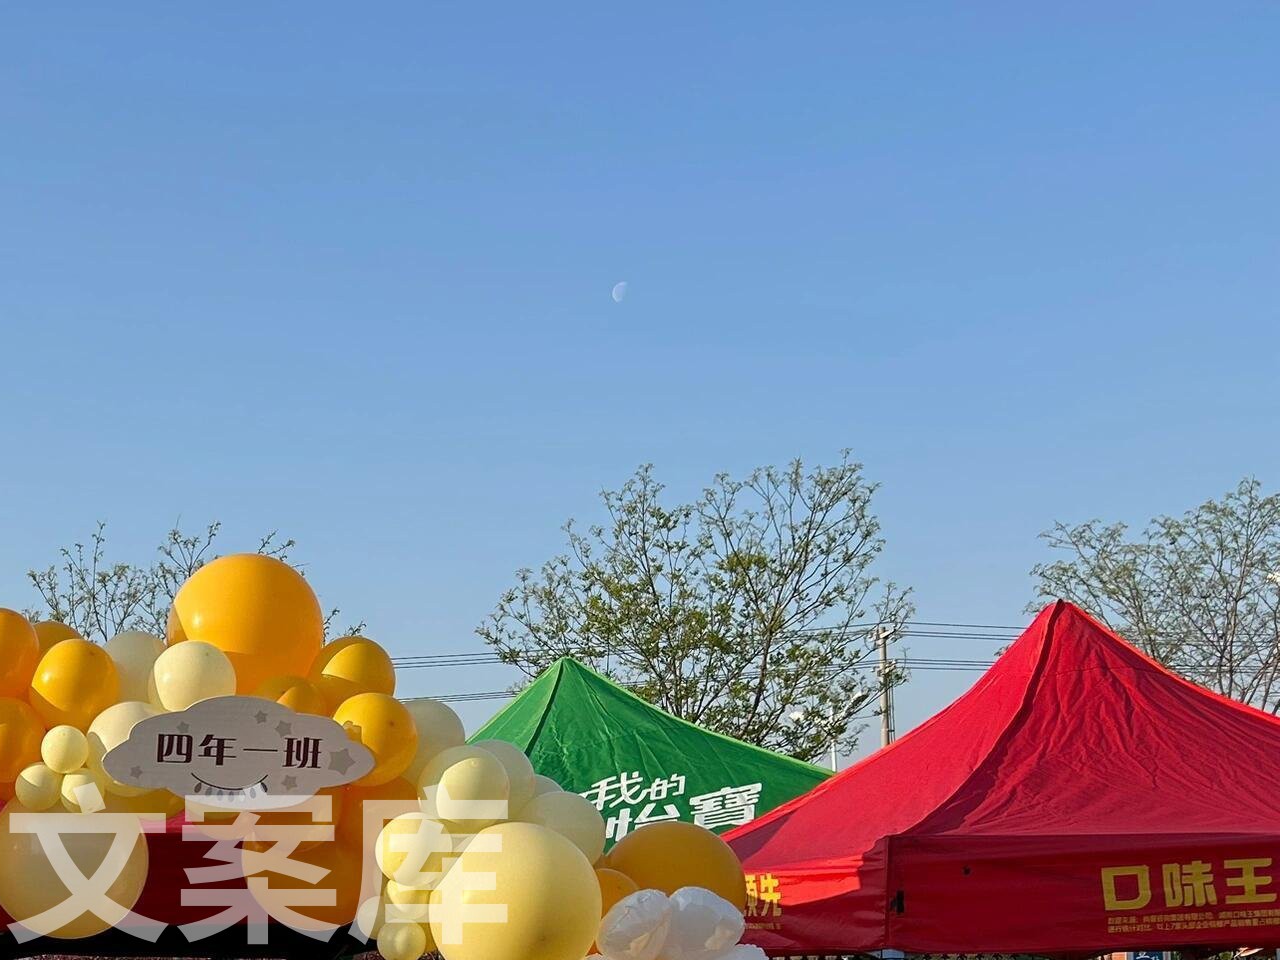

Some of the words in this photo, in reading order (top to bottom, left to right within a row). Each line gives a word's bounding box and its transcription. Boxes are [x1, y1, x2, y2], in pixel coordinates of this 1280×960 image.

[156, 733, 322, 768] 四年一班
[578, 771, 686, 811] 我的
[1101, 857, 1278, 912] 口味王
